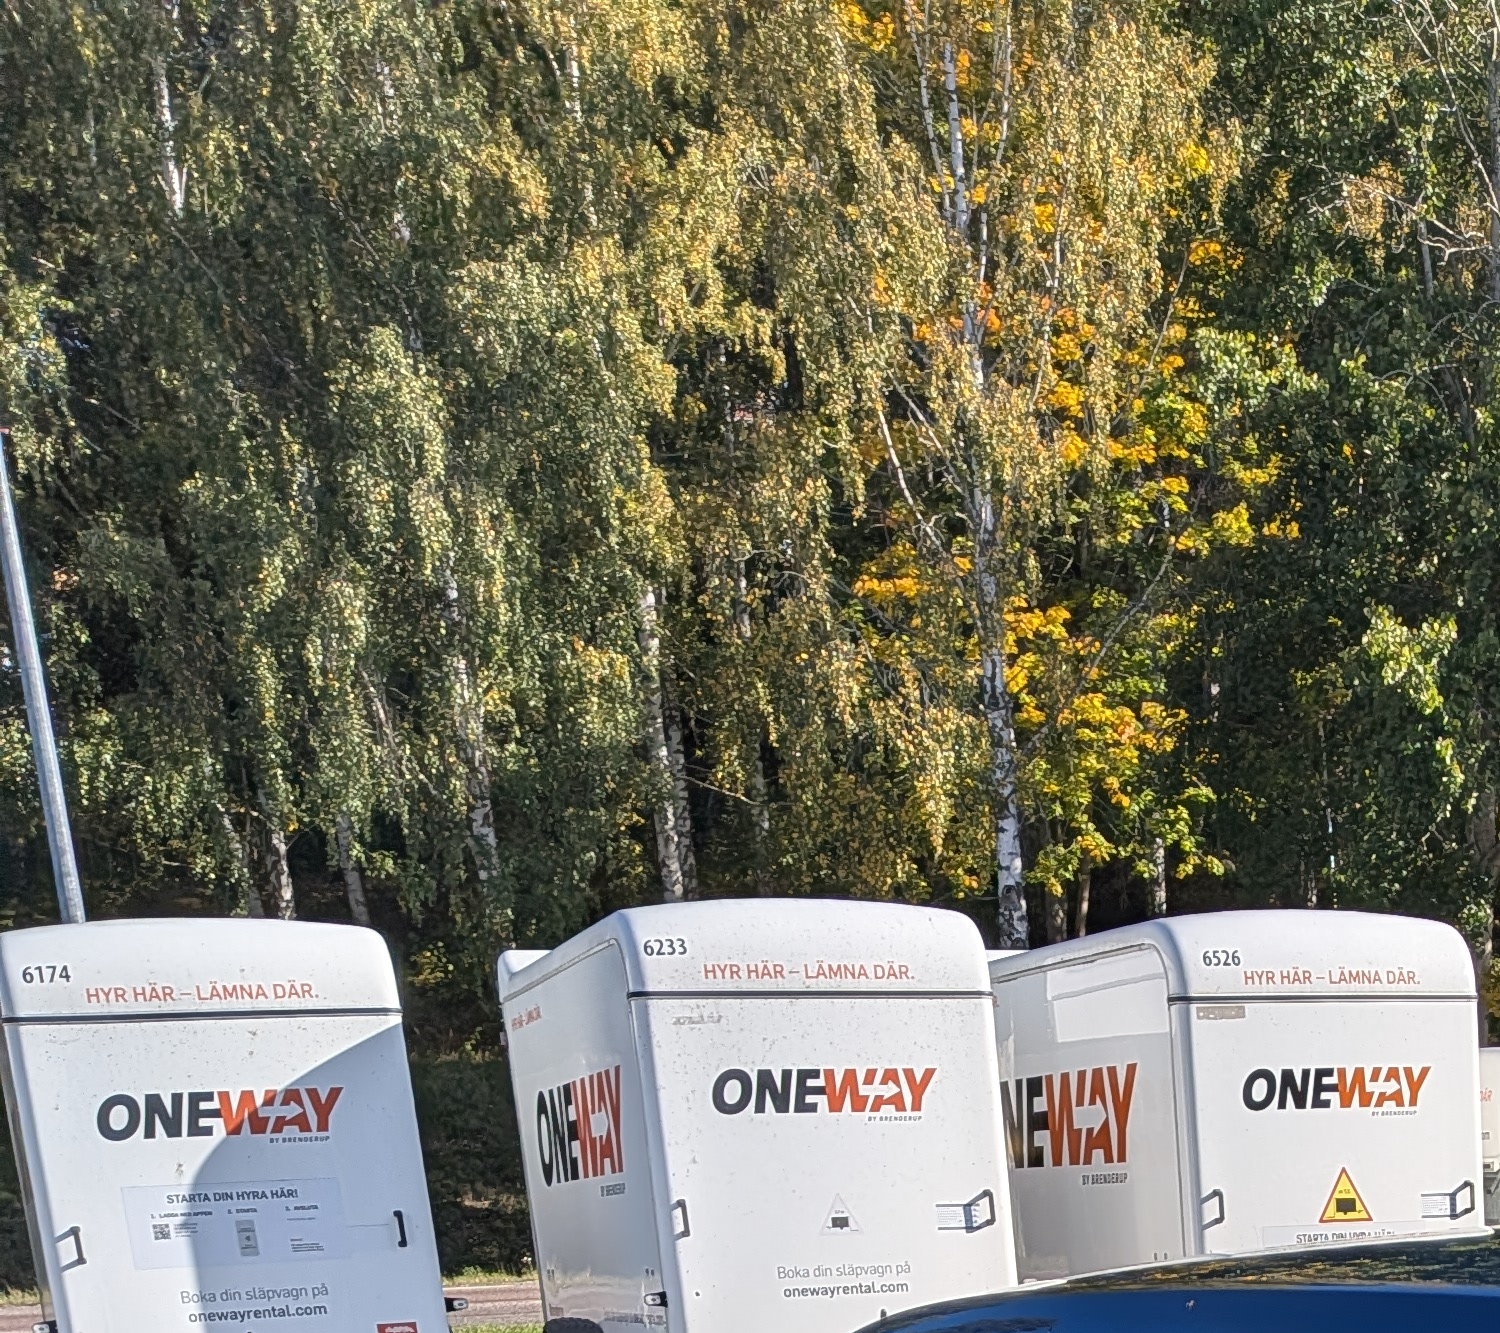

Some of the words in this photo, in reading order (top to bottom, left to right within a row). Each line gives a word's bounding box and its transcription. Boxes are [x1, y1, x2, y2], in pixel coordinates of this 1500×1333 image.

[643, 938, 688, 957] 6233
[1202, 949, 1242, 967] 6526
[21, 964, 72, 984] 6174
[703, 963, 742, 980] HYR
[746, 959, 786, 980] HÄR
[803, 959, 870, 980] LÄMNA
[874, 959, 916, 980] DÄR.
[1243, 970, 1276, 986] HYR
[1280, 966, 1313, 985] HÄR
[1328, 966, 1383, 985] LÄMNA
[1386, 966, 1421, 985] DÄR.
[85, 986, 129, 1004] HYR
[132, 982, 176, 1003] HÄR
[195, 981, 269, 1001] LÄMNA
[272, 979, 320, 1000] DÄR.
[711, 1067, 938, 1115] ONEWAY
[1242, 1066, 1432, 1112] ONEWAY
[97, 1086, 344, 1142] ONEWAY
[879, 1114, 923, 1122] BRENDERUP
[1000, 1062, 1138, 1169] NEWAY
[537, 1064, 624, 1188] ONEWAY
[1091, 1173, 1128, 1185] BRENDERUP
[166, 1192, 212, 1204] STARTA
[213, 1190, 235, 1202] DIN
[236, 1190, 269, 1201] HYRA
[270, 1187, 299, 1199] HÄR!
[777, 1264, 811, 1280] Boka
[813, 1264, 833, 1278] din
[835, 1261, 893, 1280] släpvagn
[895, 1260, 912, 1278] på
[180, 1289, 217, 1304] Boka
[220, 1288, 242, 1302] din
[245, 1284, 309, 1303] släpvagn
[311, 1282, 329, 1300] på
[783, 1281, 910, 1299] onewayrental.com
[188, 1304, 328, 1324] onewayrental.com
